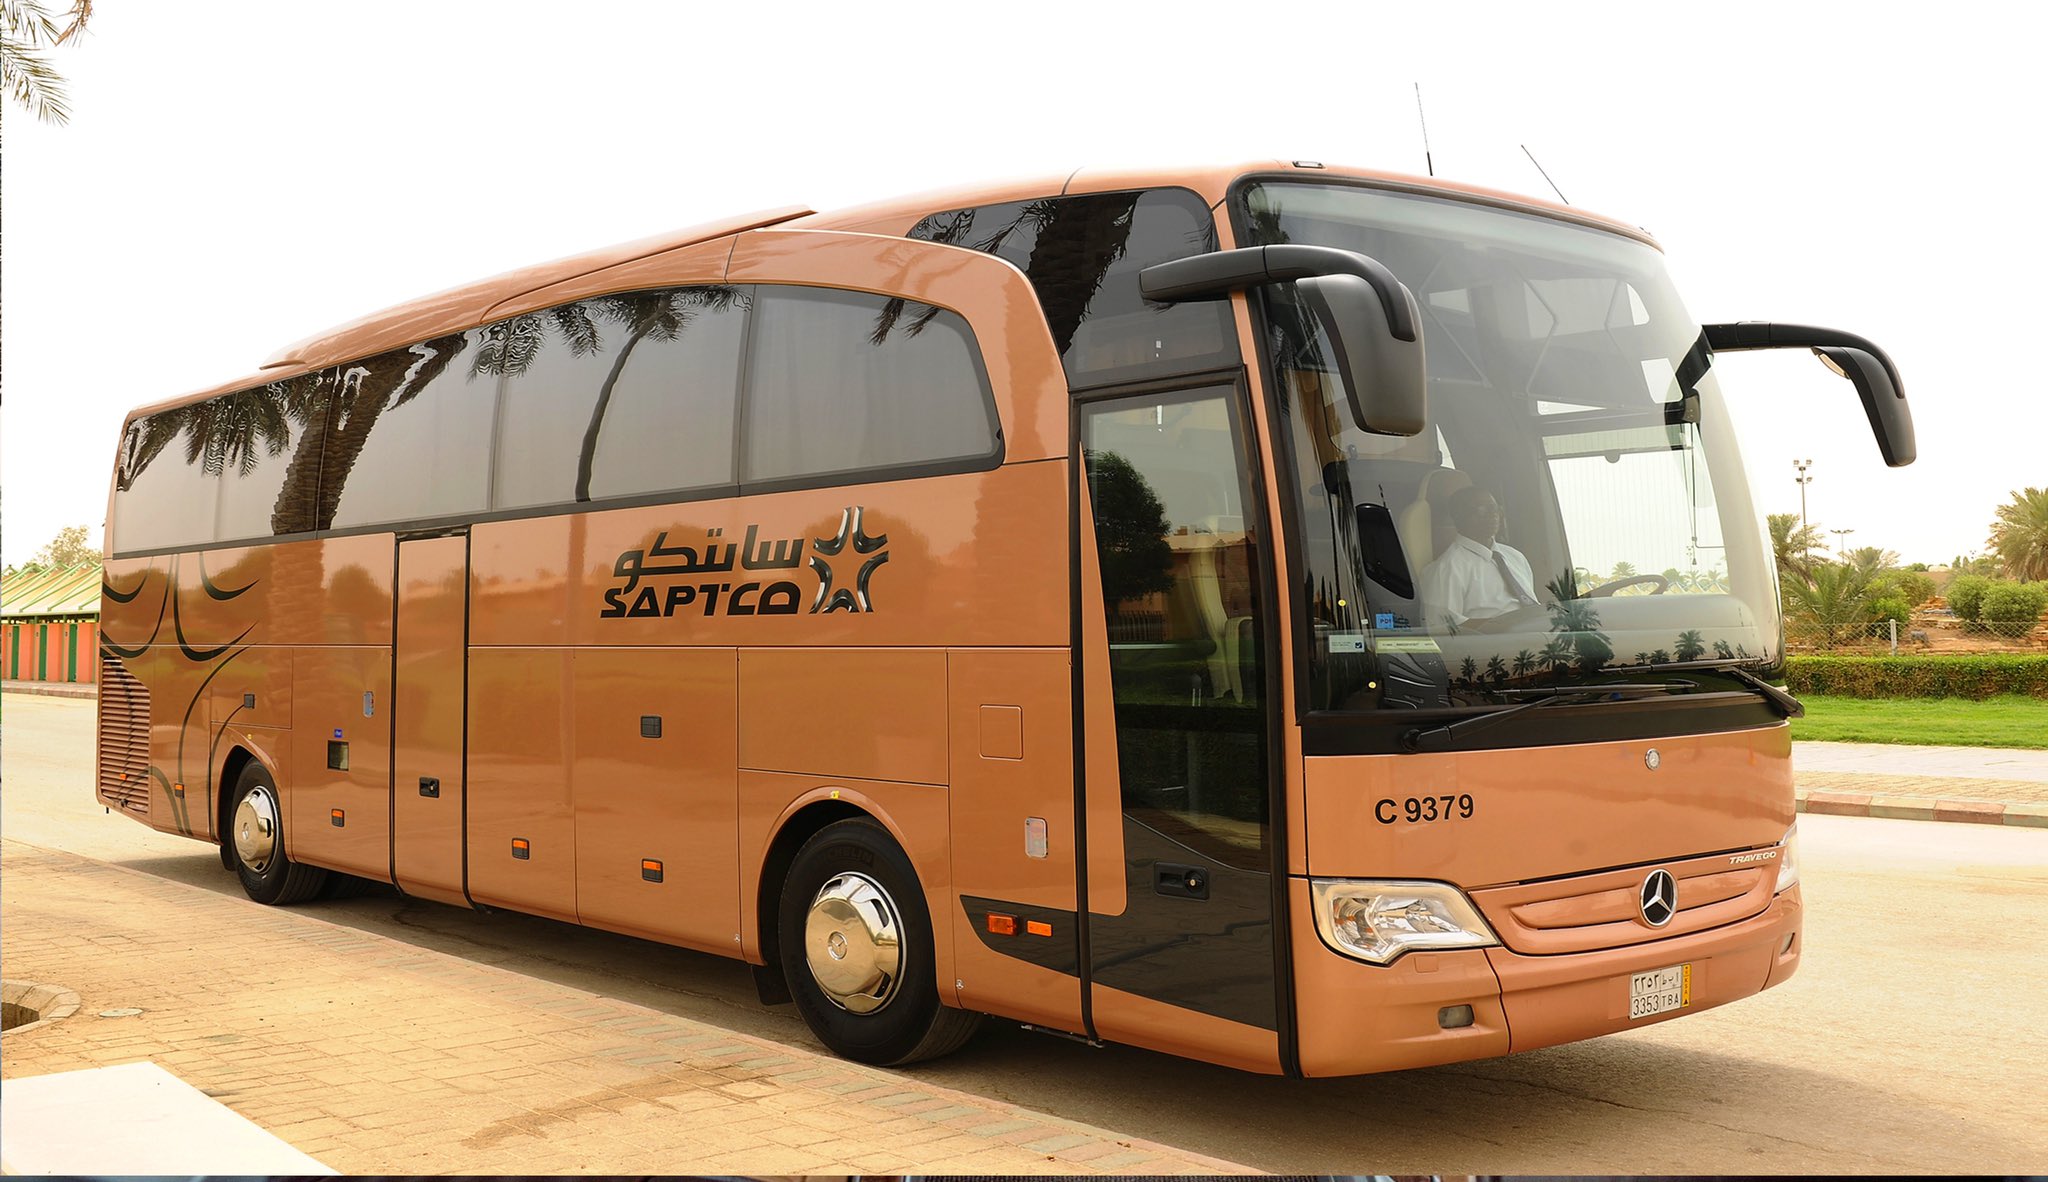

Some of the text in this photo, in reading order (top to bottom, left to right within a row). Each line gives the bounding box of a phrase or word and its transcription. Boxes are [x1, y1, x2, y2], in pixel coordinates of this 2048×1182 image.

[600, 581, 801, 618] SAPTCO
[1404, 794, 1474, 823] 9379
[1729, 851, 1777, 865] TRAVEGO
[1633, 993, 1679, 1015] 3353 TBA
